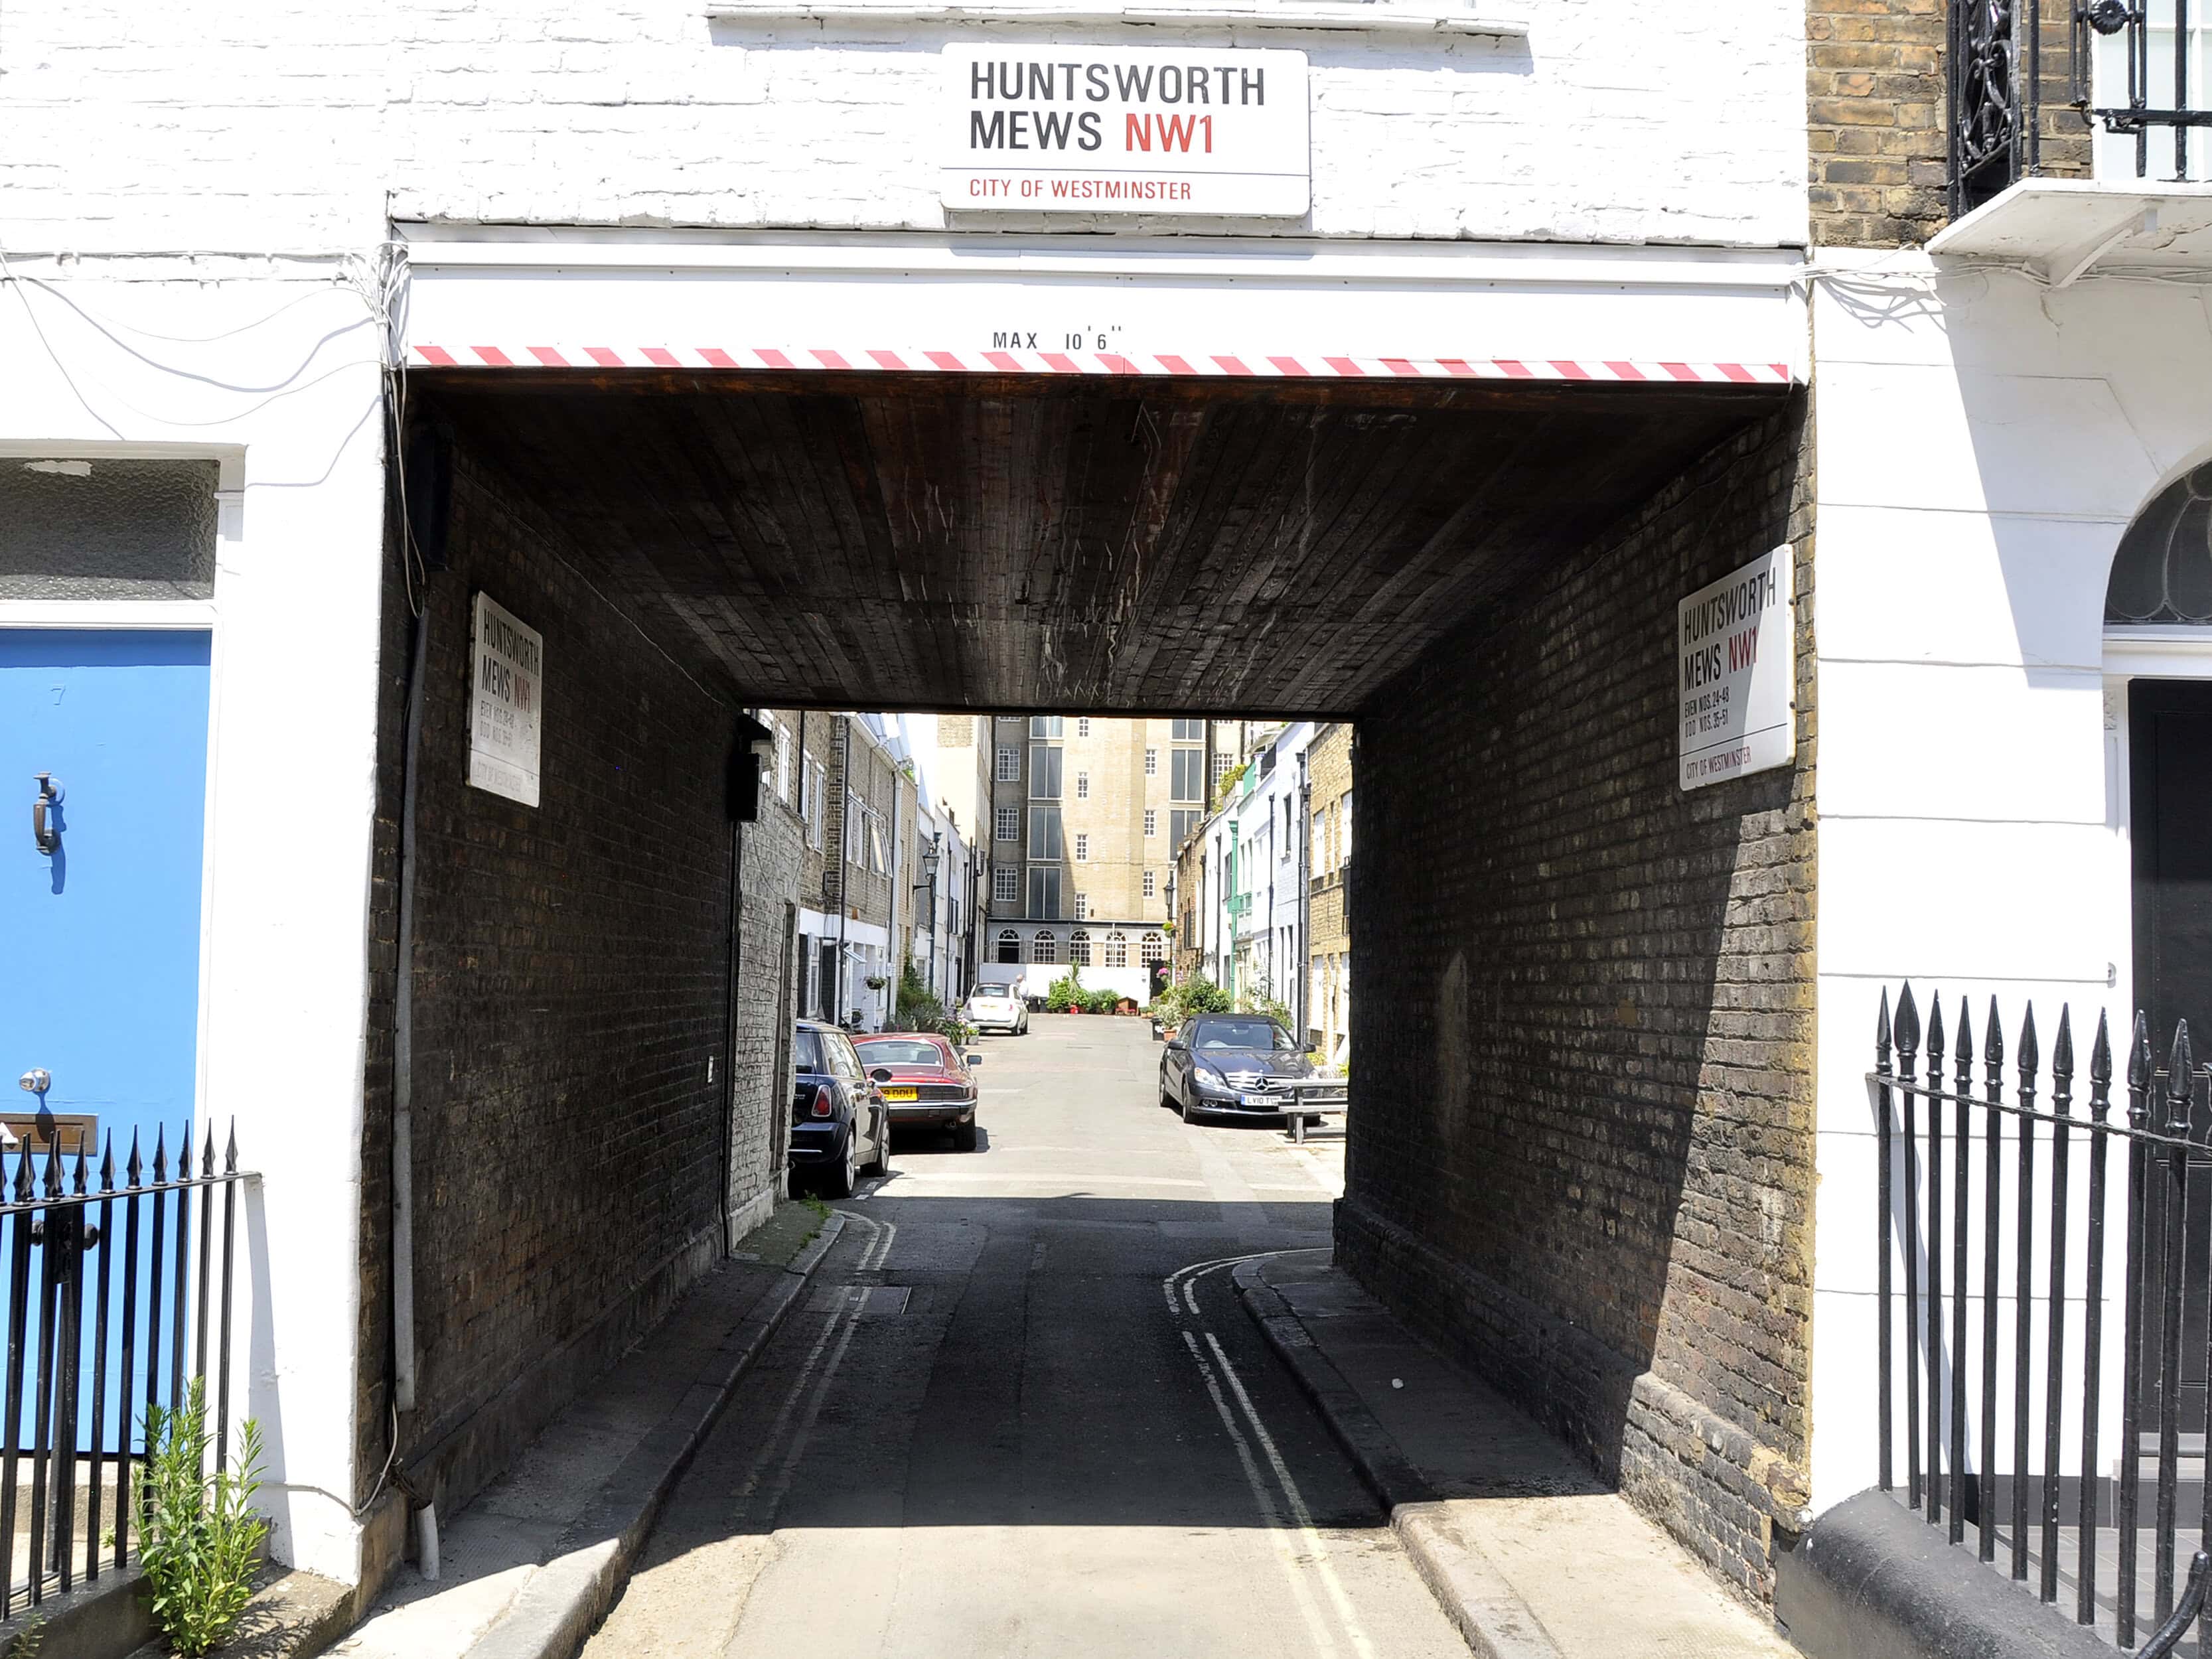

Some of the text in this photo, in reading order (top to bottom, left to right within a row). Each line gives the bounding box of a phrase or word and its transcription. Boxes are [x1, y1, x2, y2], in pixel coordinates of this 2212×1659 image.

[970, 61, 1265, 106] HUNTSWORTH
[970, 110, 1213, 153] MEWS NW1
[970, 179, 1191, 200] CITY OF WESTMINSTER
[993, 330, 1038, 350] MAX
[1684, 567, 1777, 646] HUNTSWORTH
[482, 609, 540, 678] HUNTSWORTH
[1684, 626, 1758, 692] MEWS NW1
[481, 654, 511, 704] MEWS
[1684, 699, 1698, 719] EVEN
[1686, 746, 1752, 779] CITY OF WESTMINSTER
